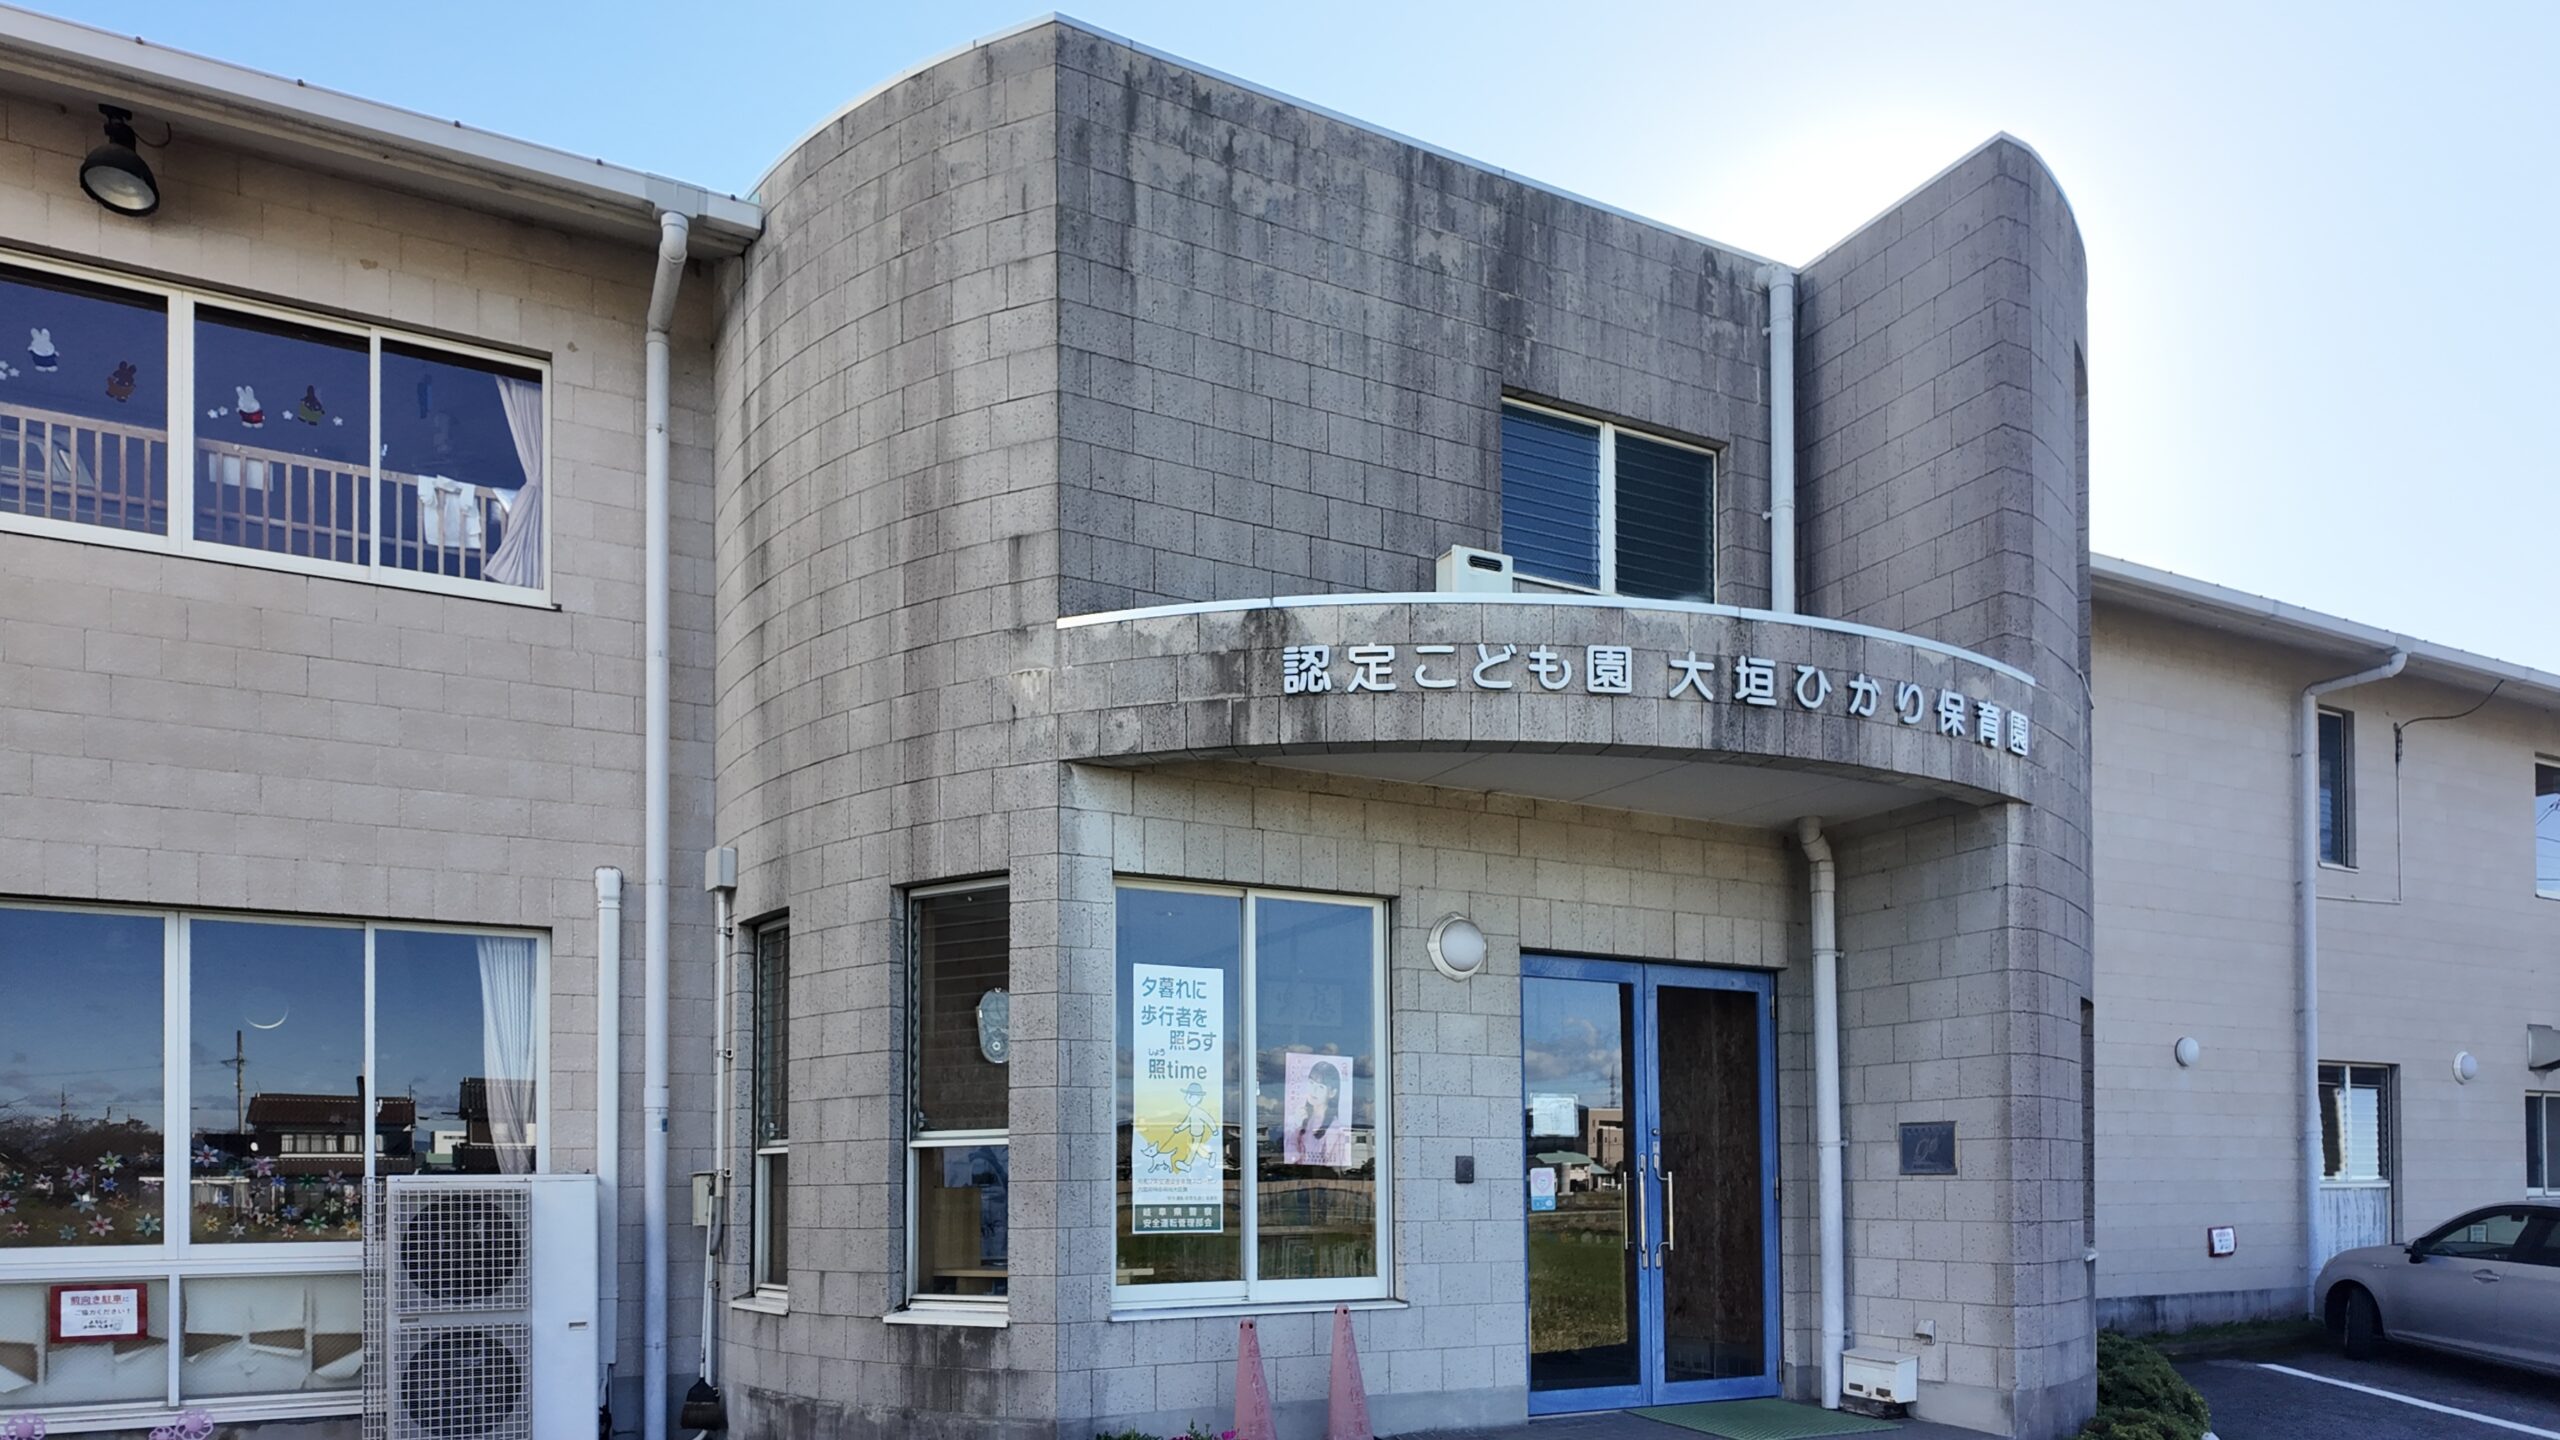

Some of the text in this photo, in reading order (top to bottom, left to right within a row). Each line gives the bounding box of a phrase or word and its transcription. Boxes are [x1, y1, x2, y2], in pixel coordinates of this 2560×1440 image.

[1282, 642, 2029, 757] 認定こども園 大垣ひかり保育園
[1141, 976, 1208, 999] 夕暮れに
[1141, 1004, 1208, 1028] 歩行者を
[1169, 1030, 1217, 1051] 照らす
[1148, 1048, 1165, 1056] しょう
[1148, 1058, 1208, 1080] 照time
